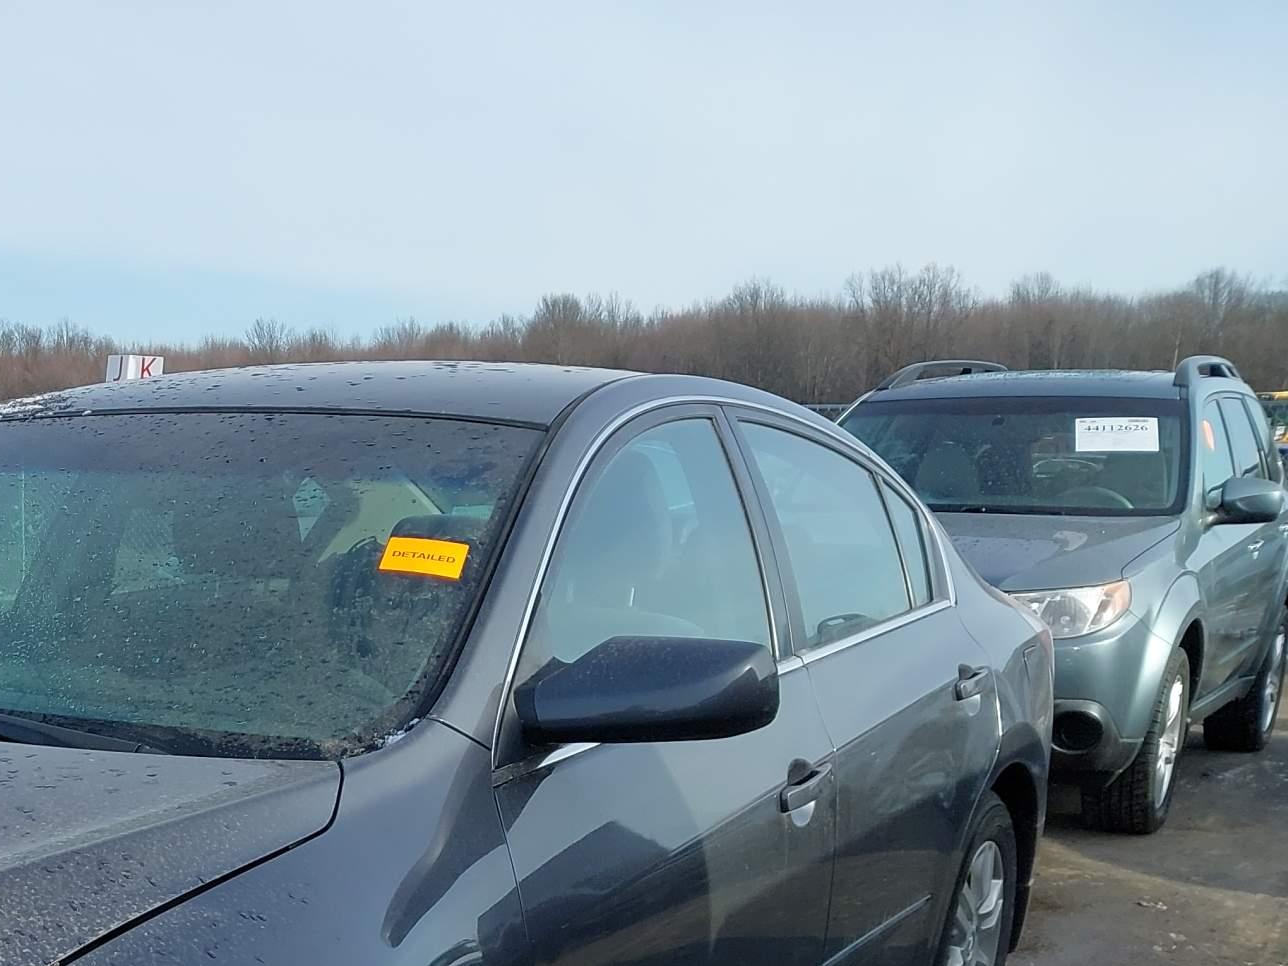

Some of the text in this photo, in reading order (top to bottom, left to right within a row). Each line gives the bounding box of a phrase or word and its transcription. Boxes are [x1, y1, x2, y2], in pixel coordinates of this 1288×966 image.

[113, 356, 124, 381] J
[140, 357, 157, 379] K
[1083, 424, 1149, 432] 44112626
[392, 550, 456, 563] DETAILED
